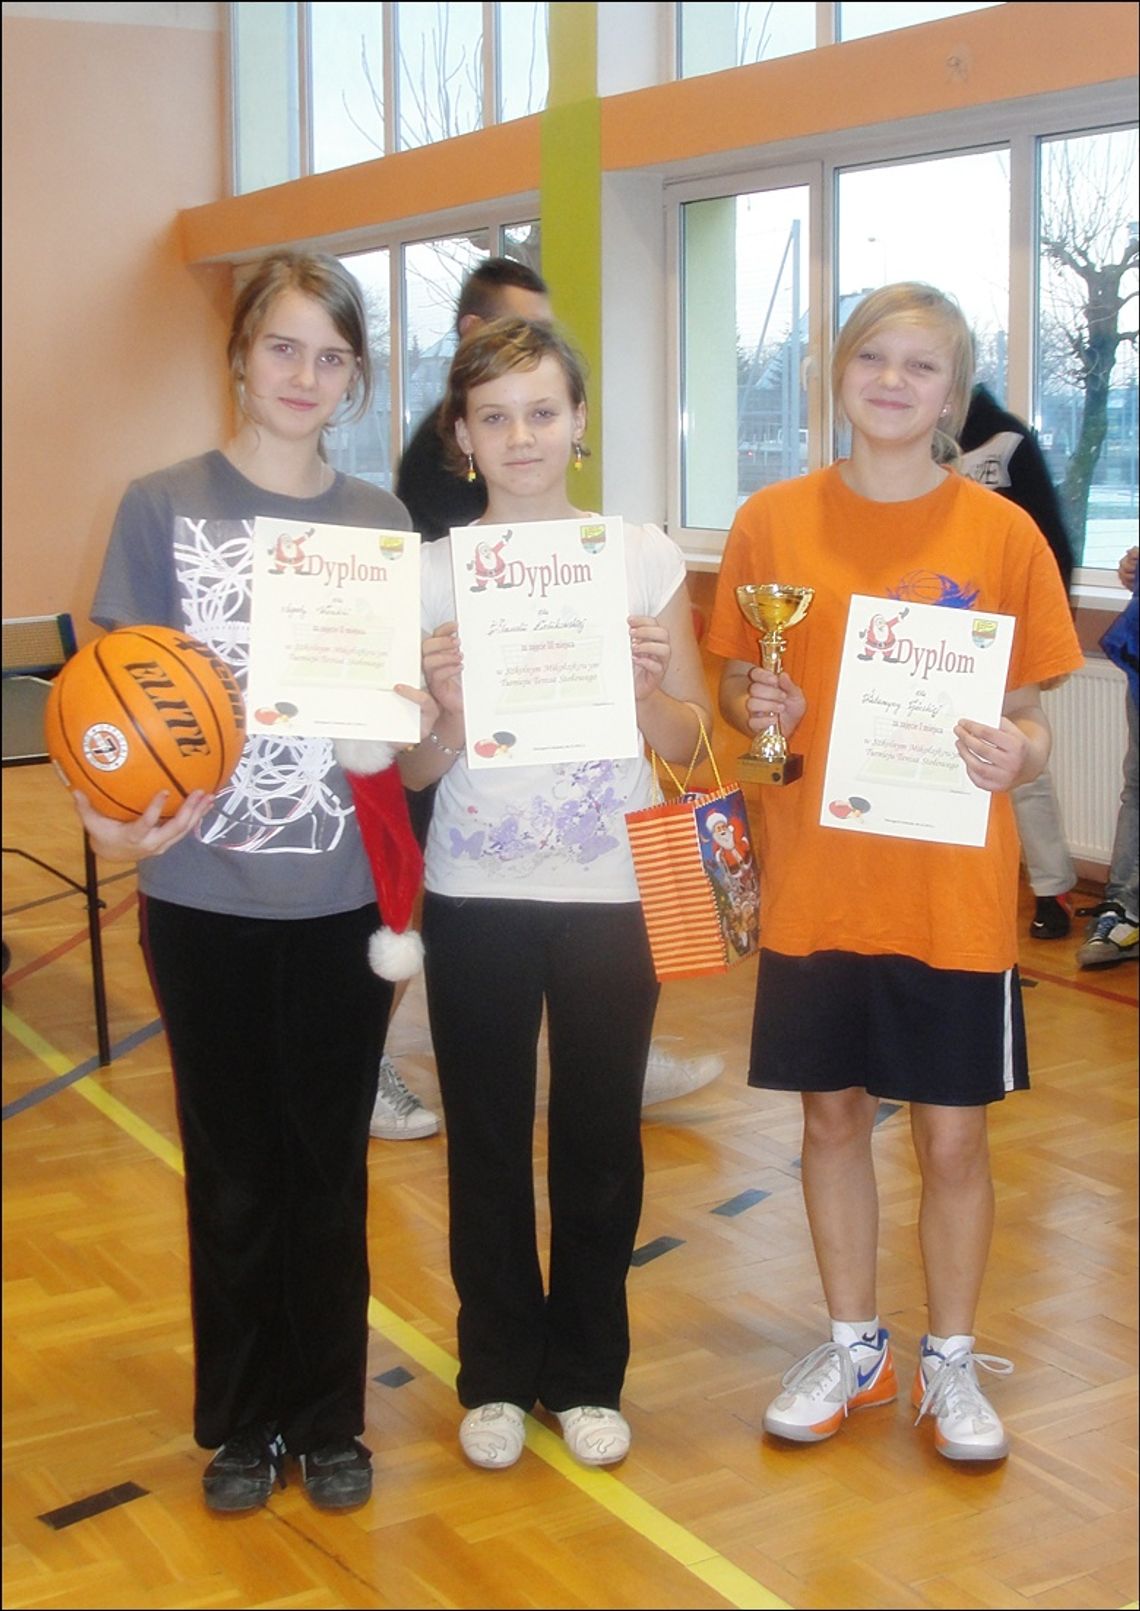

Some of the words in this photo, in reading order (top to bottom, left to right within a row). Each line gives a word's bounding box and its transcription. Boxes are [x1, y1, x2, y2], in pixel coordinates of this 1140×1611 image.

[304, 554, 388, 588] Dyplom
[508, 553, 592, 598] Dyplom
[896, 638, 976, 681] Dyplom
[123, 661, 212, 758] ELITE
